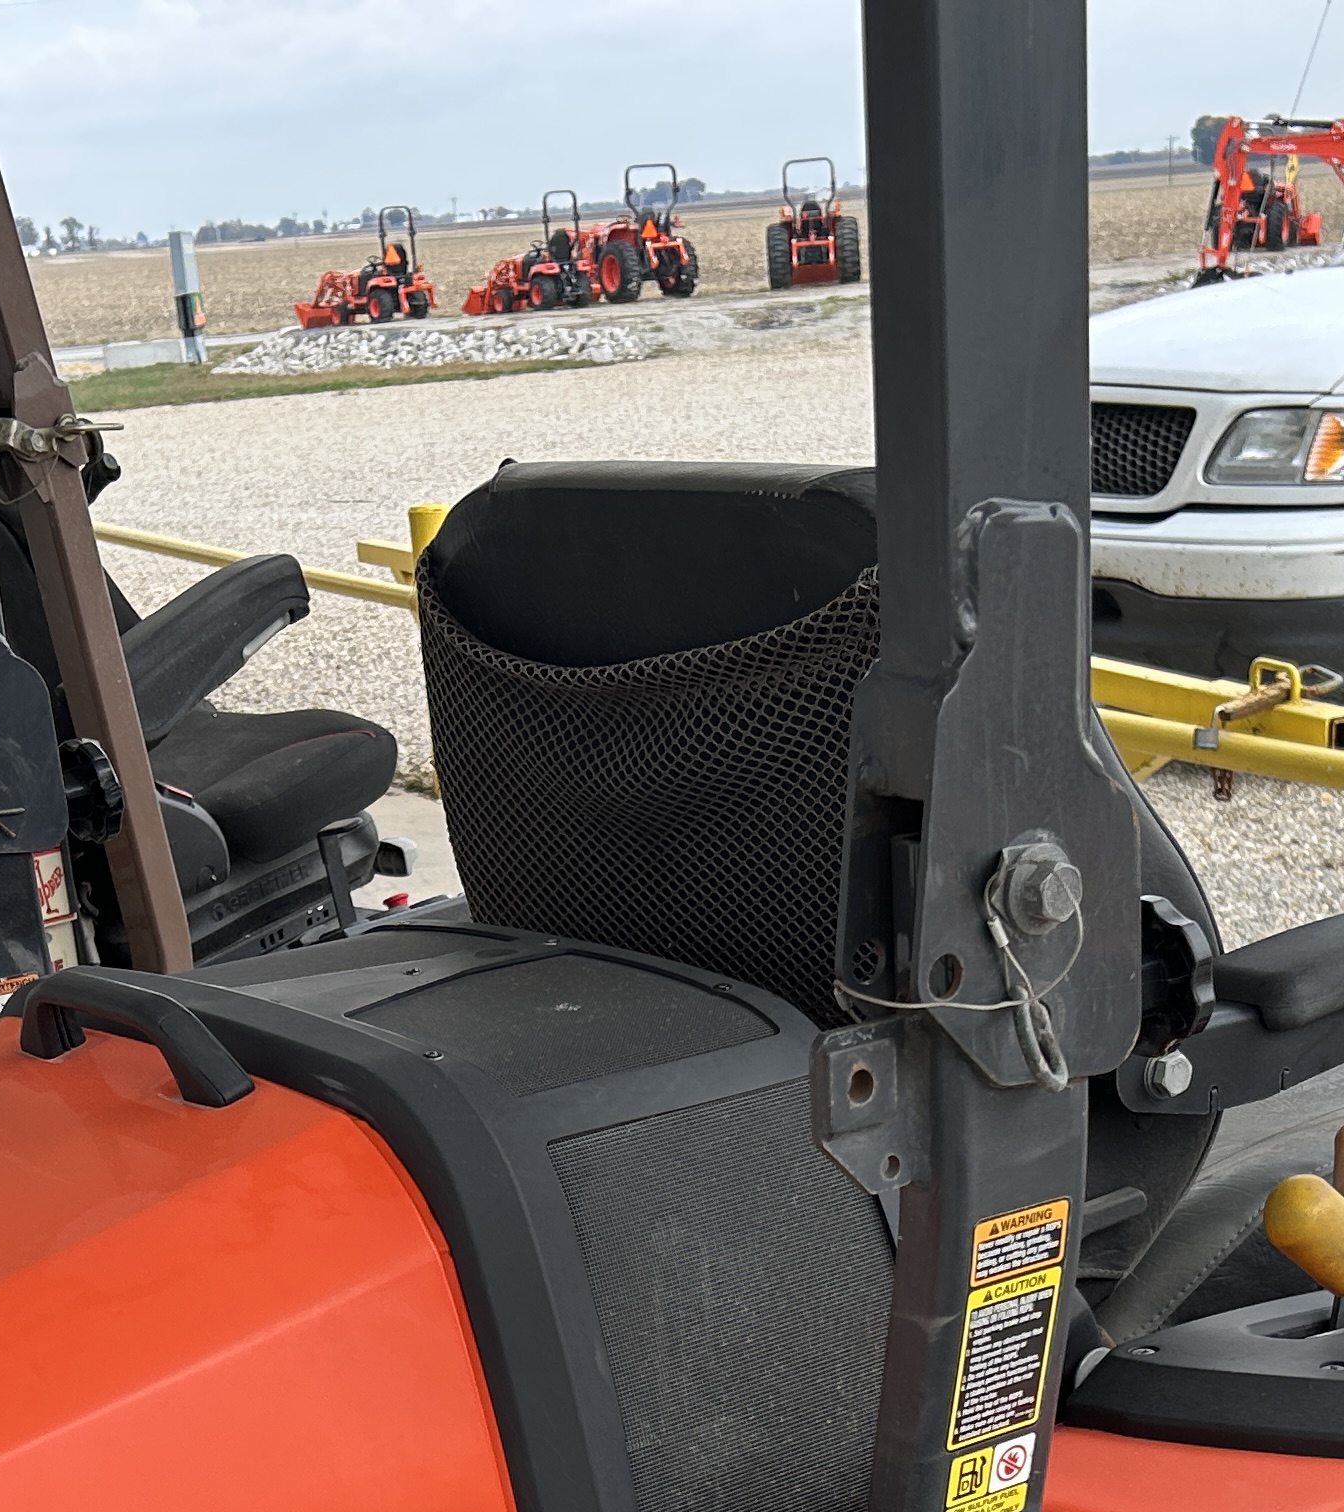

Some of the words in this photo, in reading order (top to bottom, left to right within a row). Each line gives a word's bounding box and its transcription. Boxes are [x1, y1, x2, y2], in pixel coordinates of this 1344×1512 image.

[1000, 1207, 1053, 1232] WARNING
[994, 1273, 1047, 1299] CAUTION
[967, 1495, 998, 1512] SULFUR
[1000, 1488, 1020, 1500] FUEL
[987, 1501, 1005, 1512] LOW
